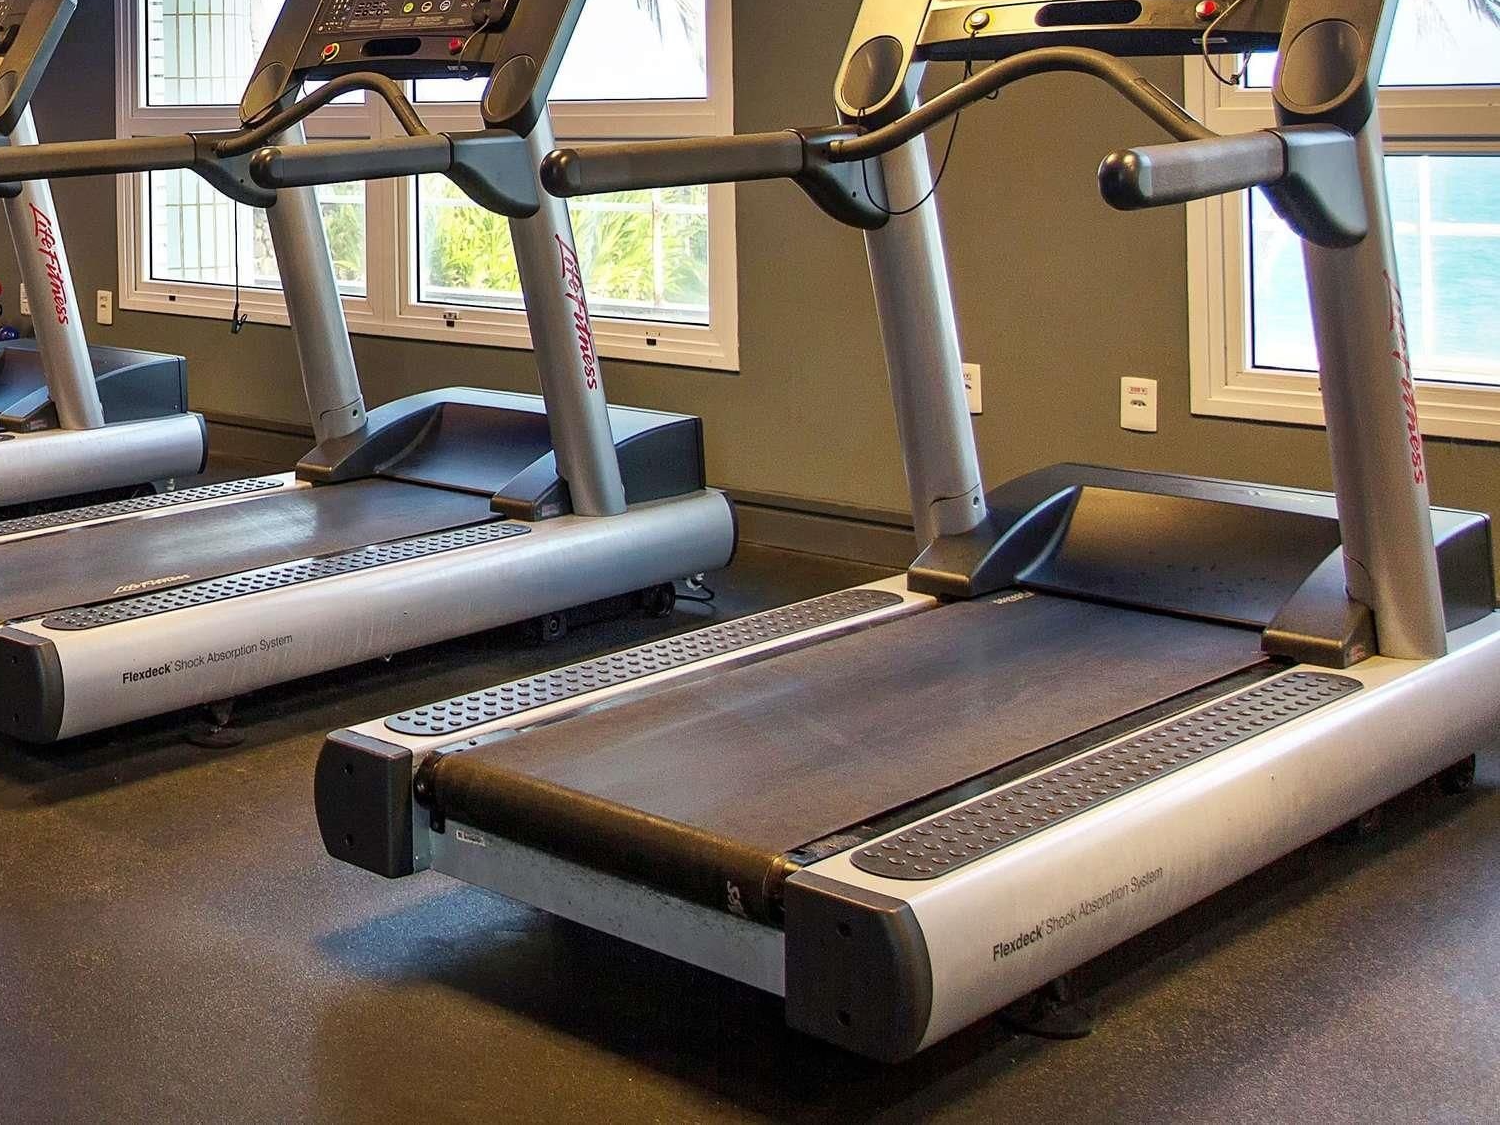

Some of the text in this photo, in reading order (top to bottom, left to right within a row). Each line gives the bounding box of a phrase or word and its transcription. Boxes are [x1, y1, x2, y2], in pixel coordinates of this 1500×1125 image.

[122, 633, 293, 684] Flexdeck Shock Absorption System
[992, 867, 1164, 962] Flexdeck Shock Absorption System
